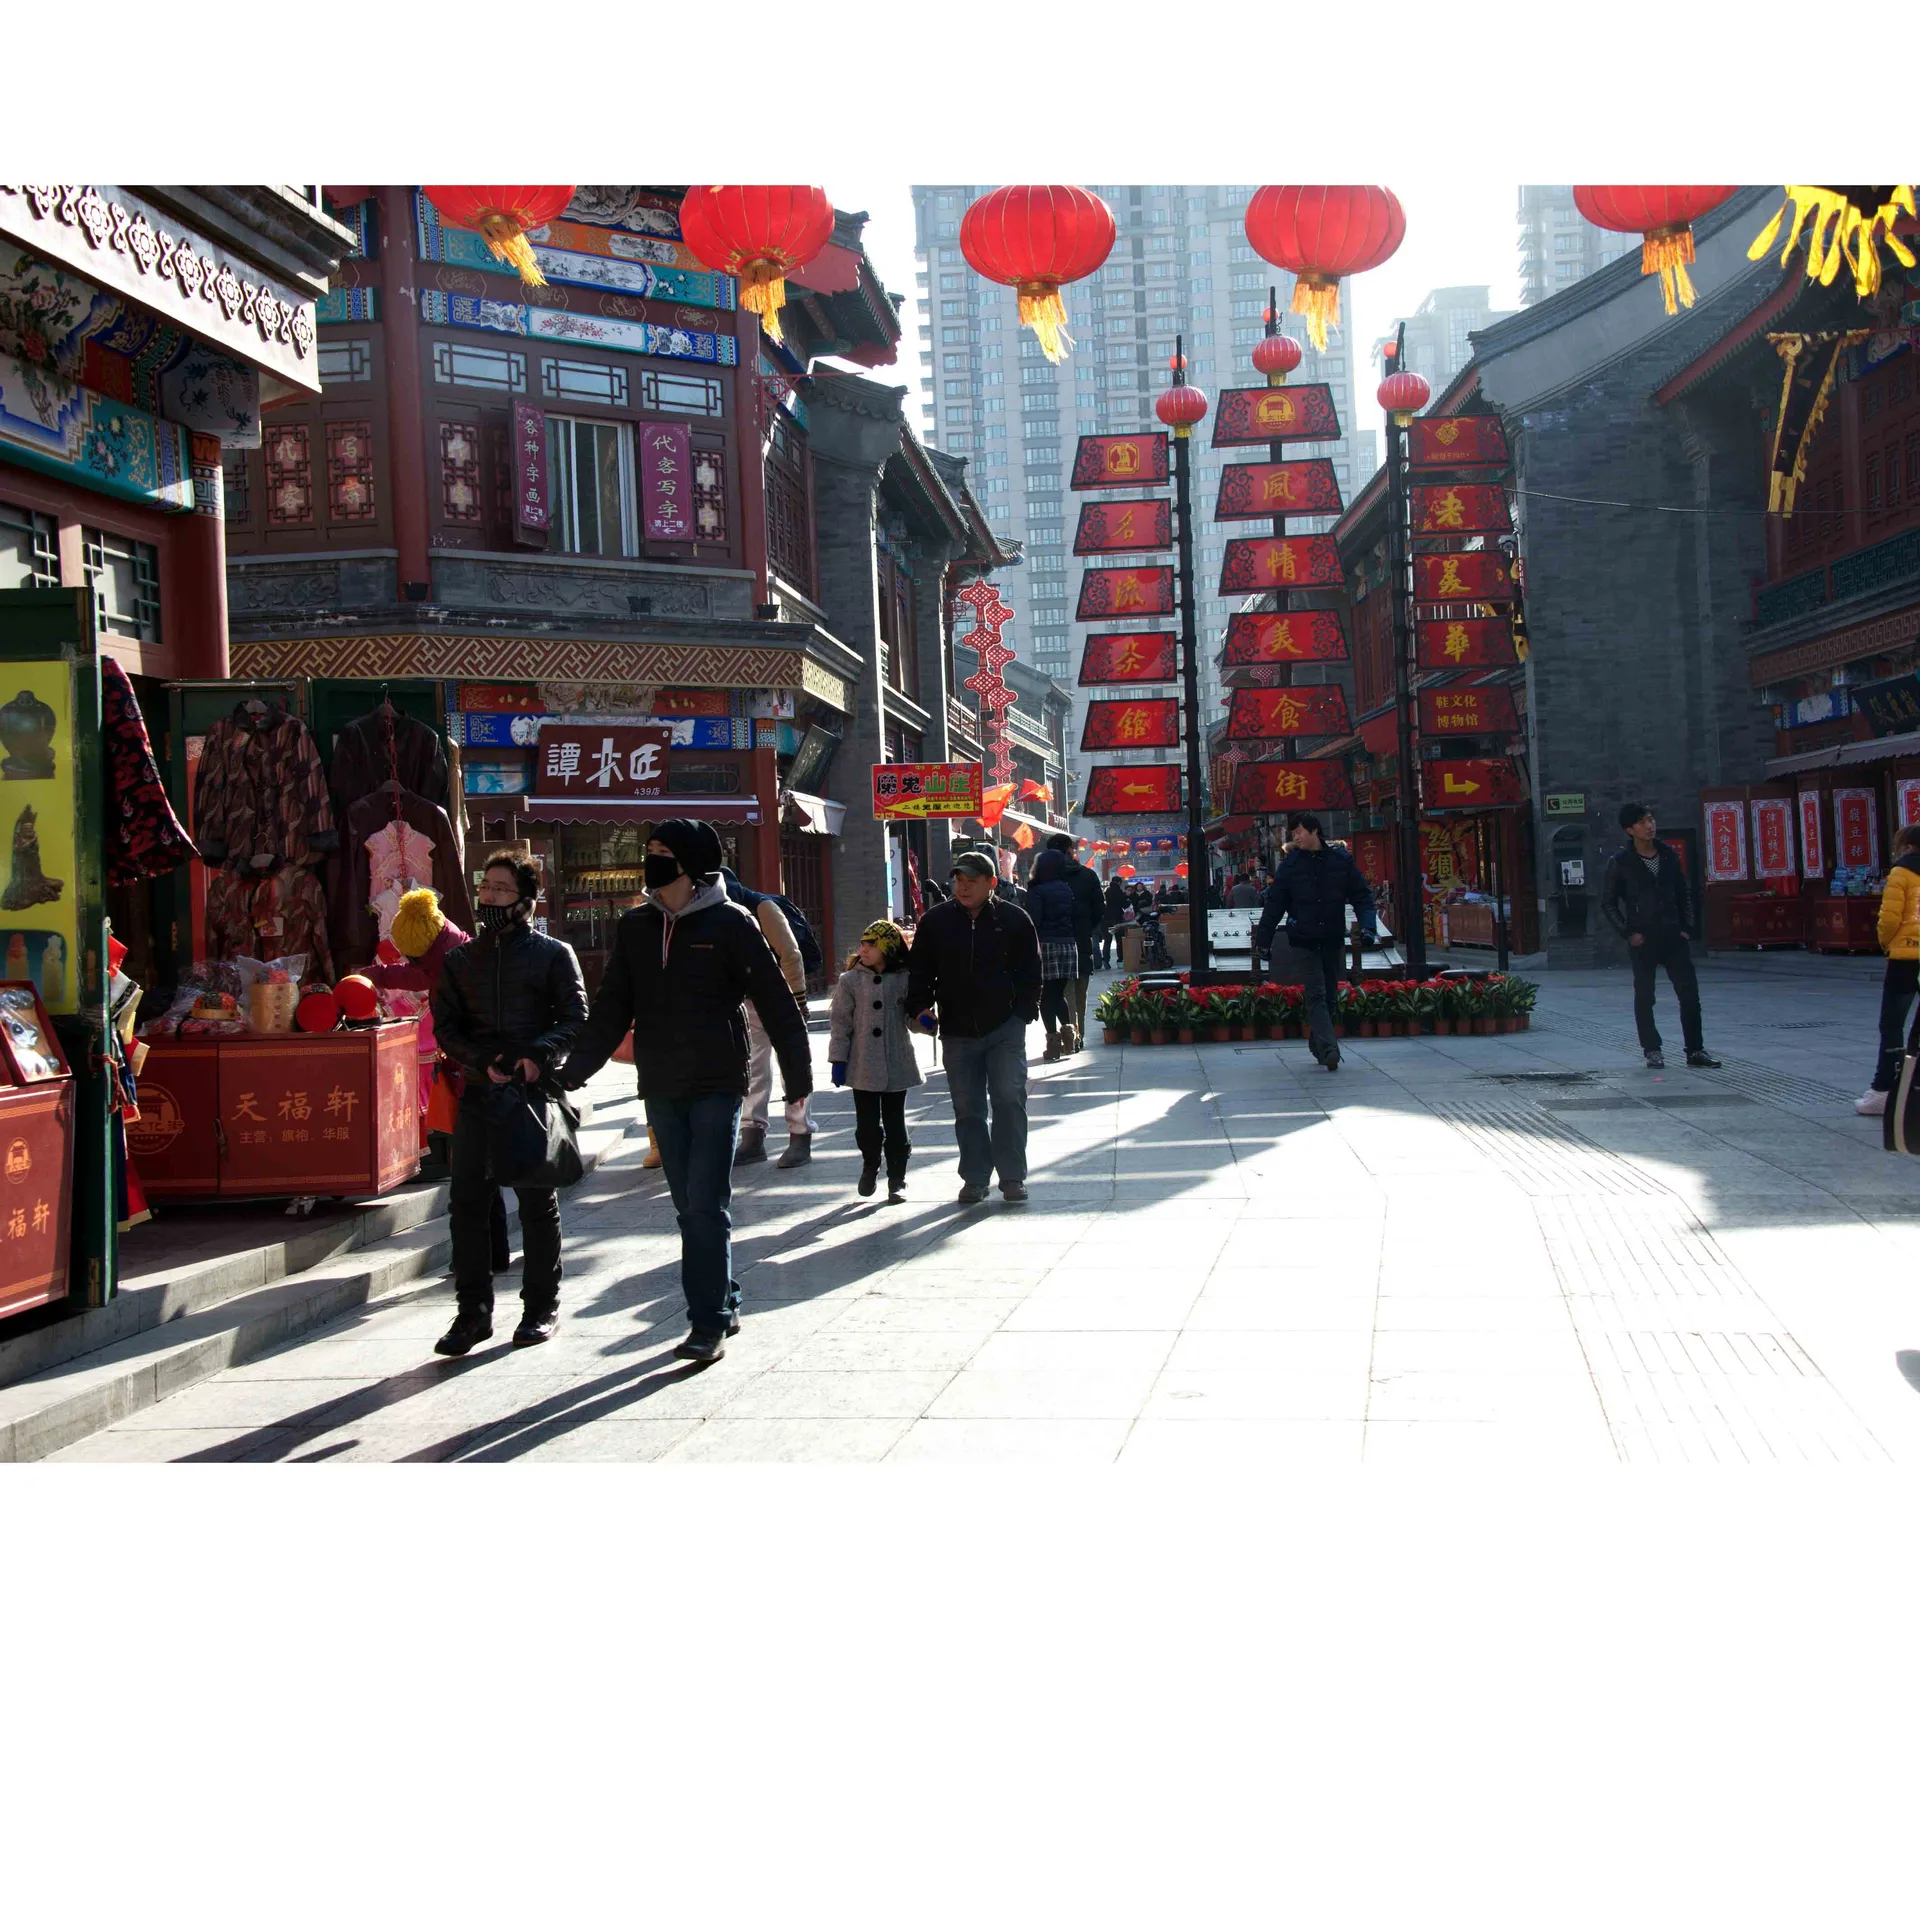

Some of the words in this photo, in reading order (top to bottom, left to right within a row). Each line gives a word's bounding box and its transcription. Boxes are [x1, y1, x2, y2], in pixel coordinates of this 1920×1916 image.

[524, 419, 540, 503] 各种字画
[652, 434, 679, 519] 代客写字
[654, 519, 684, 528] 请上二楼
[1436, 694, 1477, 709] 鞋文化
[1437, 713, 1479, 728] 博物馆
[546, 737, 662, 787] 譚木匠
[634, 787, 661, 796] 439店
[1718, 813, 1733, 868] 十八街麻花
[231, 1085, 360, 1122] 天福轩
[128, 1119, 186, 1136] 文化街
[0, 1198, 50, 1243] 福轩
